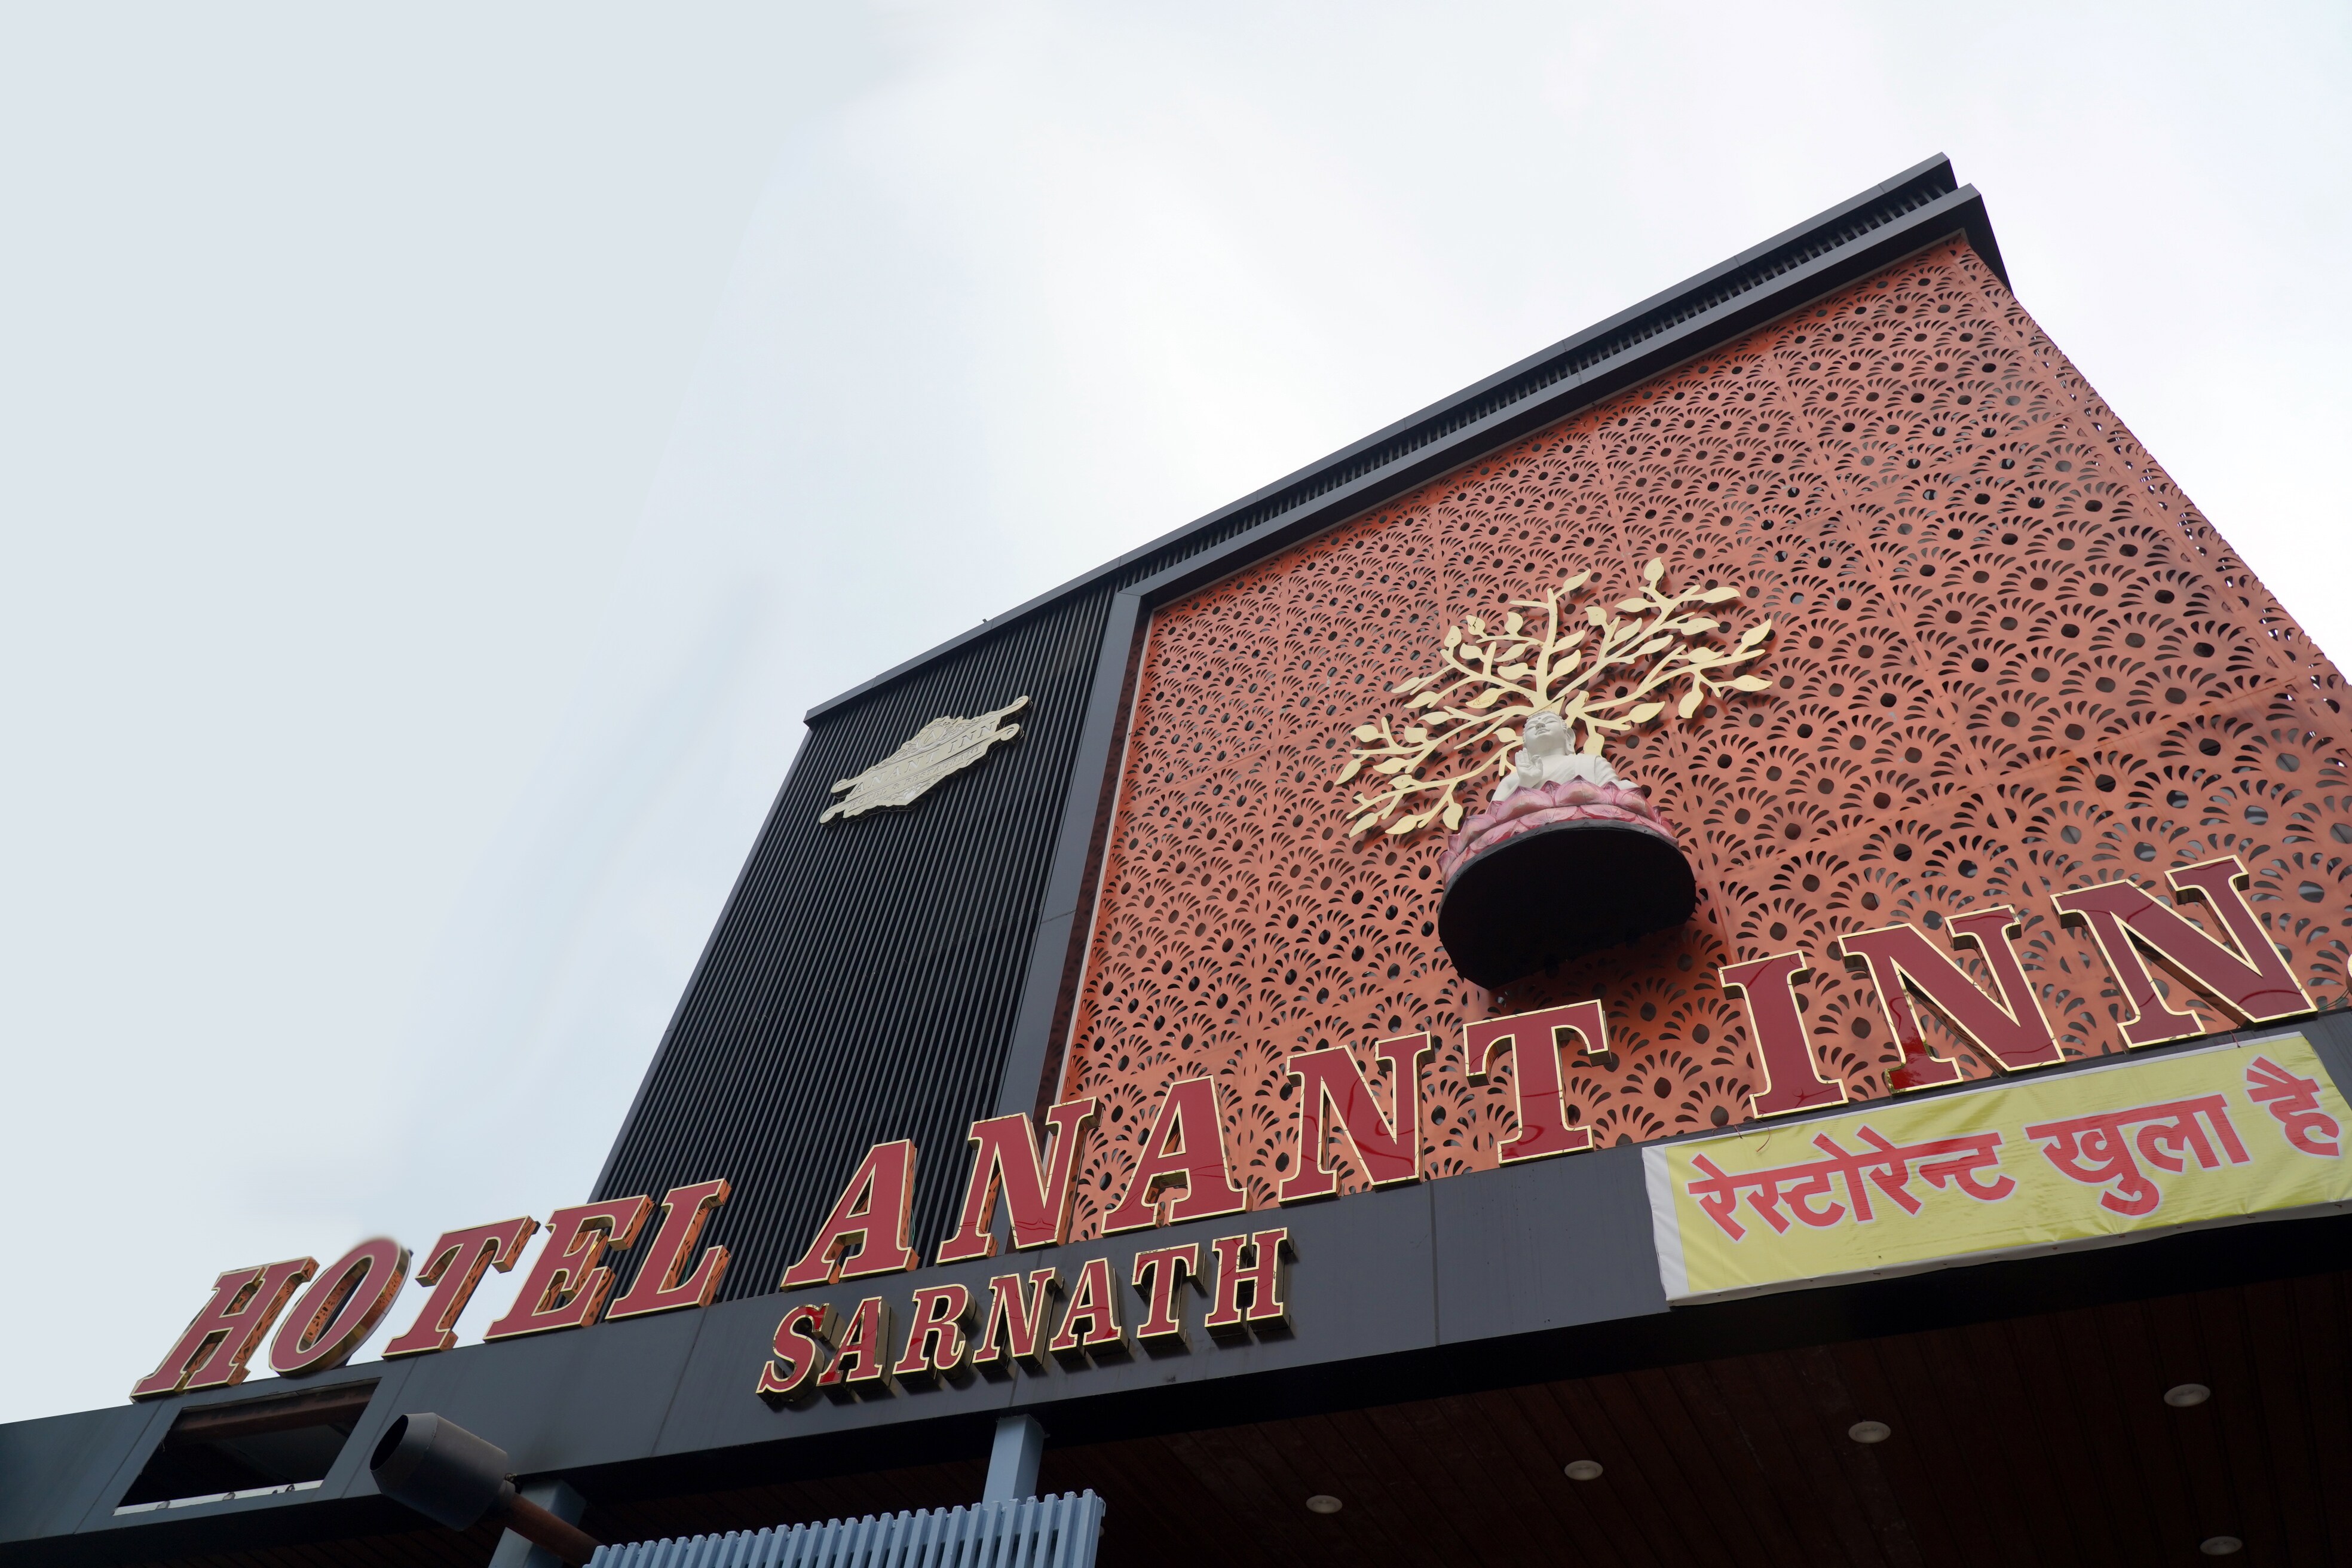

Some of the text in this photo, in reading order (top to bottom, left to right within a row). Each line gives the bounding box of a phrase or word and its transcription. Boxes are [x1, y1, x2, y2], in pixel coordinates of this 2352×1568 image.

[849, 788, 887, 809] HOTEL
[903, 745, 981, 785] RESTAURANT
[850, 721, 996, 797] ANANT INN
[130, 854, 2319, 1403] HOTEL ANANT INN
[1688, 1056, 2341, 1242] रेस्टोरेन्ट खुला है
[755, 1227, 1294, 1401] SARNATH
